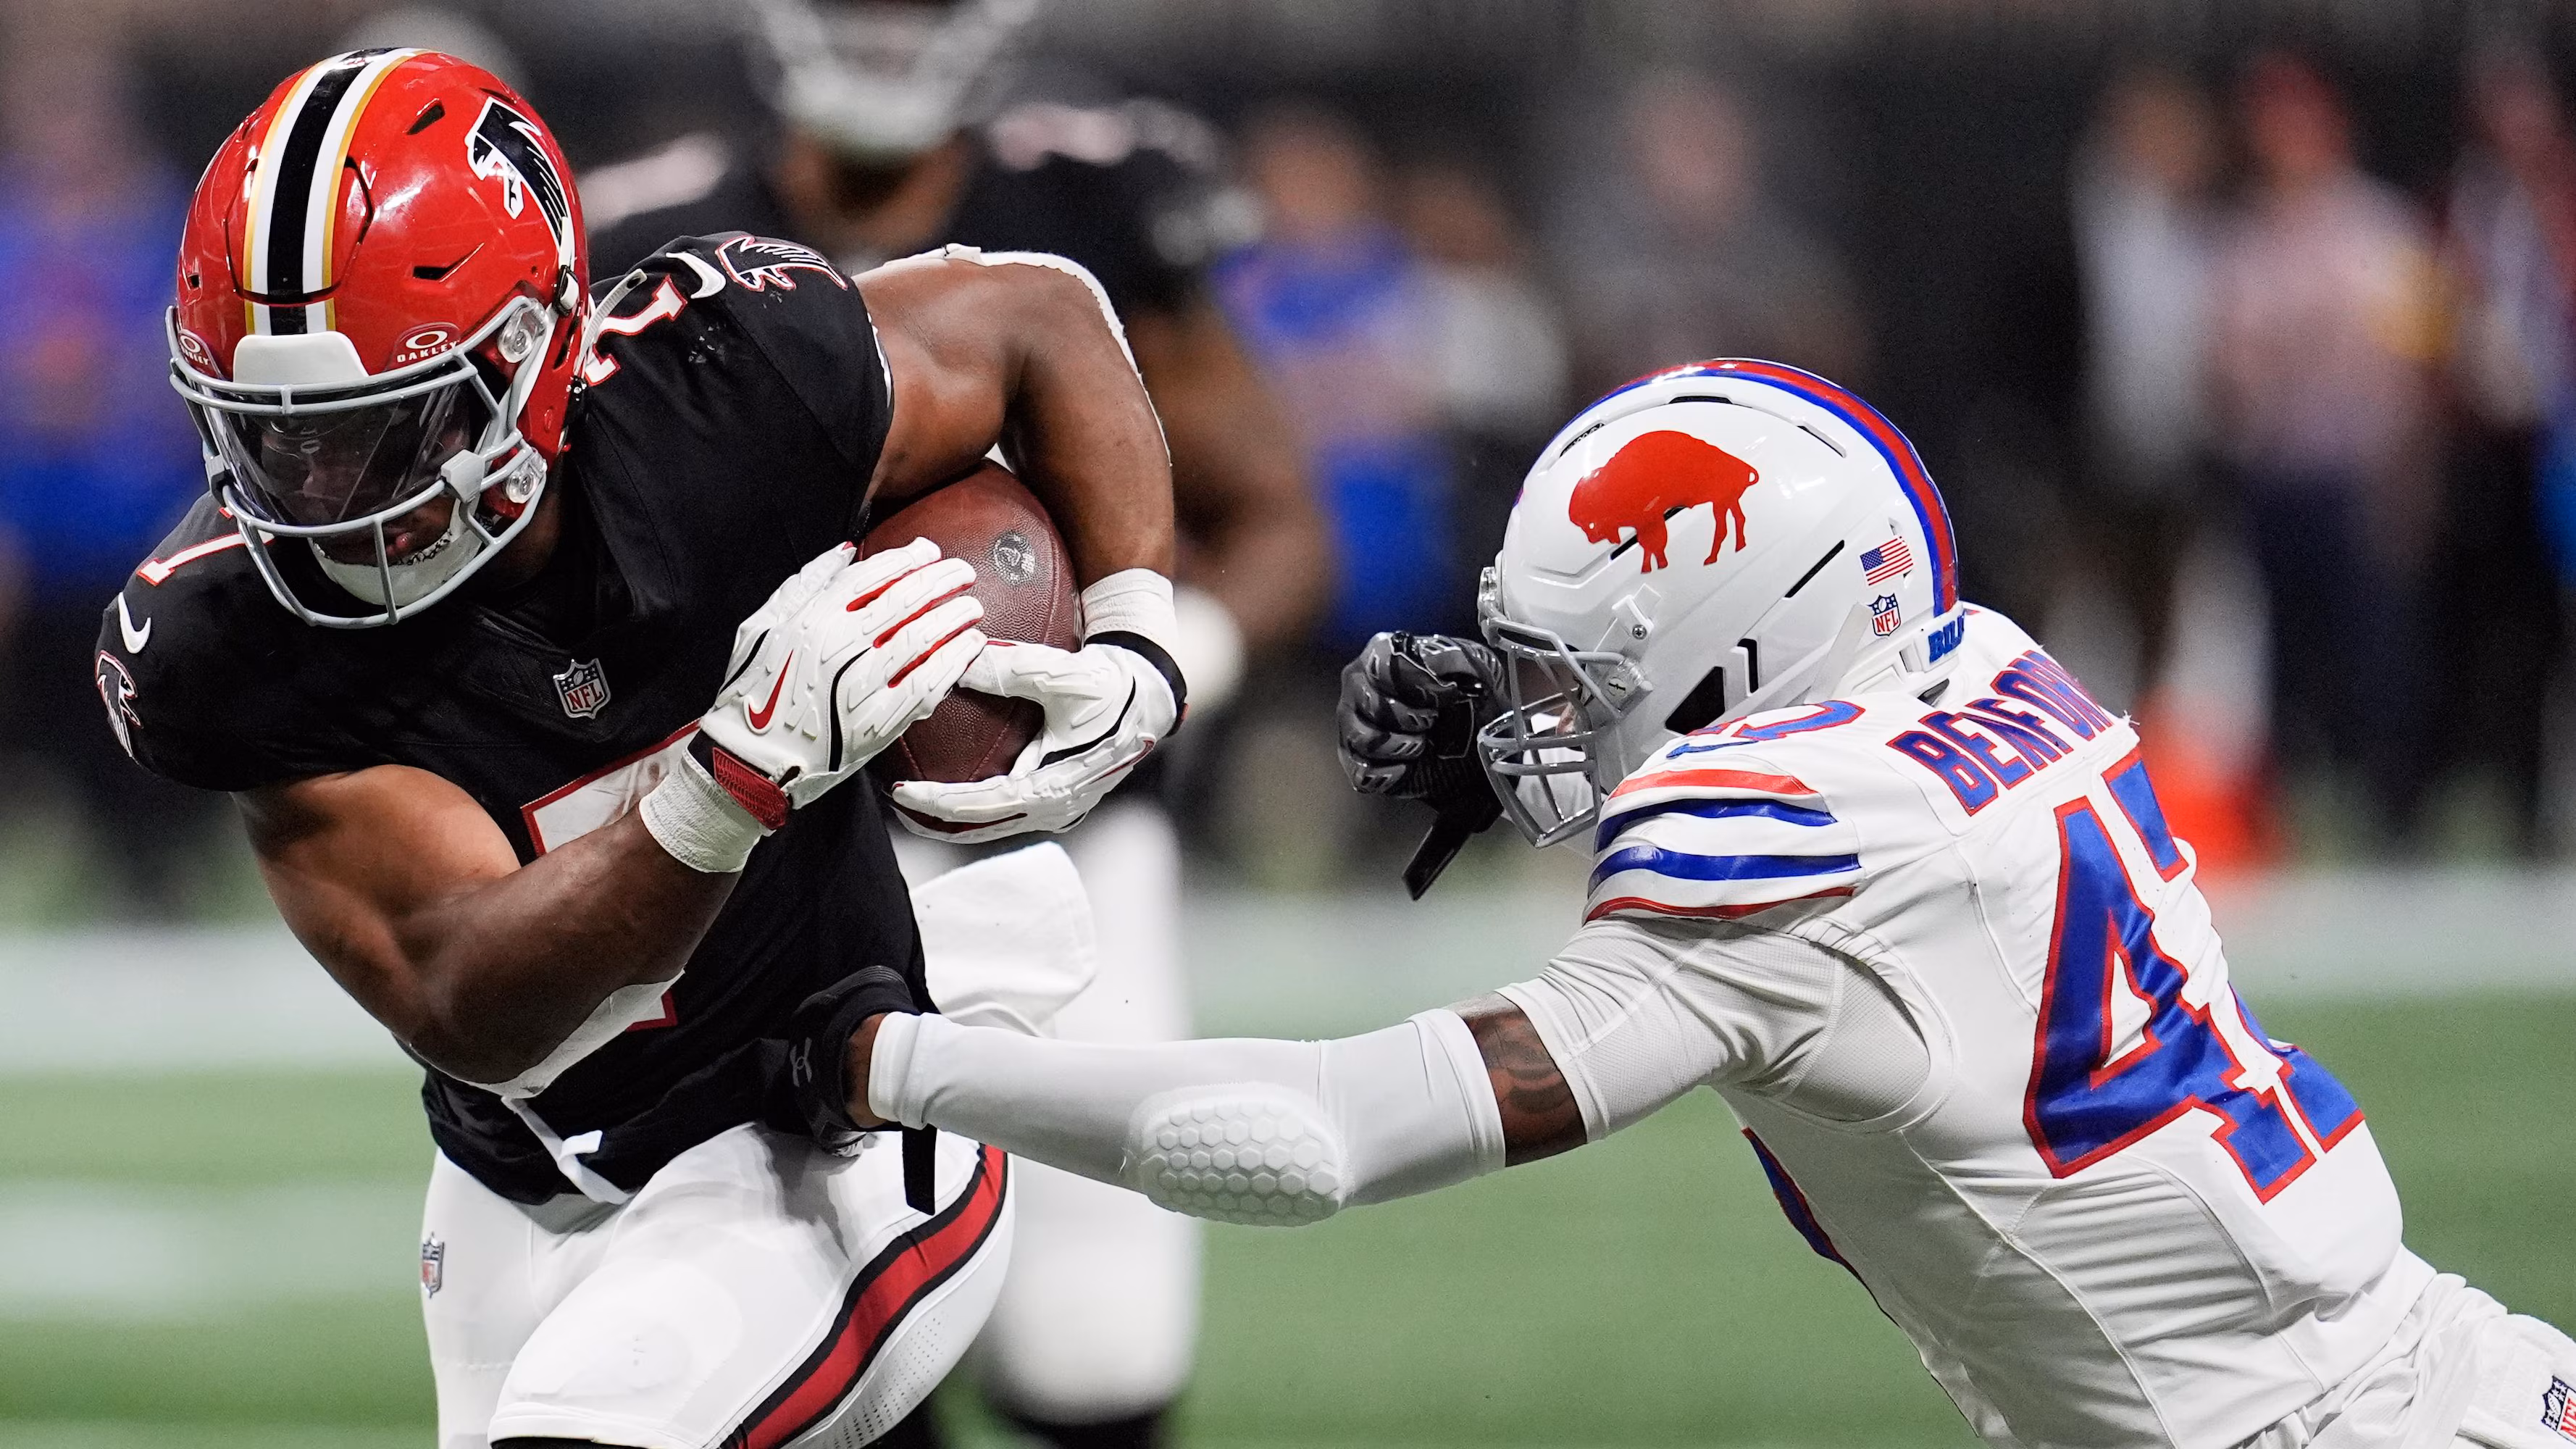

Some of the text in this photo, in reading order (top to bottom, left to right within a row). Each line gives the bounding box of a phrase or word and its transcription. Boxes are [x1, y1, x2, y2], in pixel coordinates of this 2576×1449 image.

[183, 346, 209, 365] AKLEY
[396, 340, 458, 363] OAKLEY
[1875, 610, 1899, 633] NFL
[1928, 609, 1965, 664] BILL
[567, 682, 603, 710] NFL
